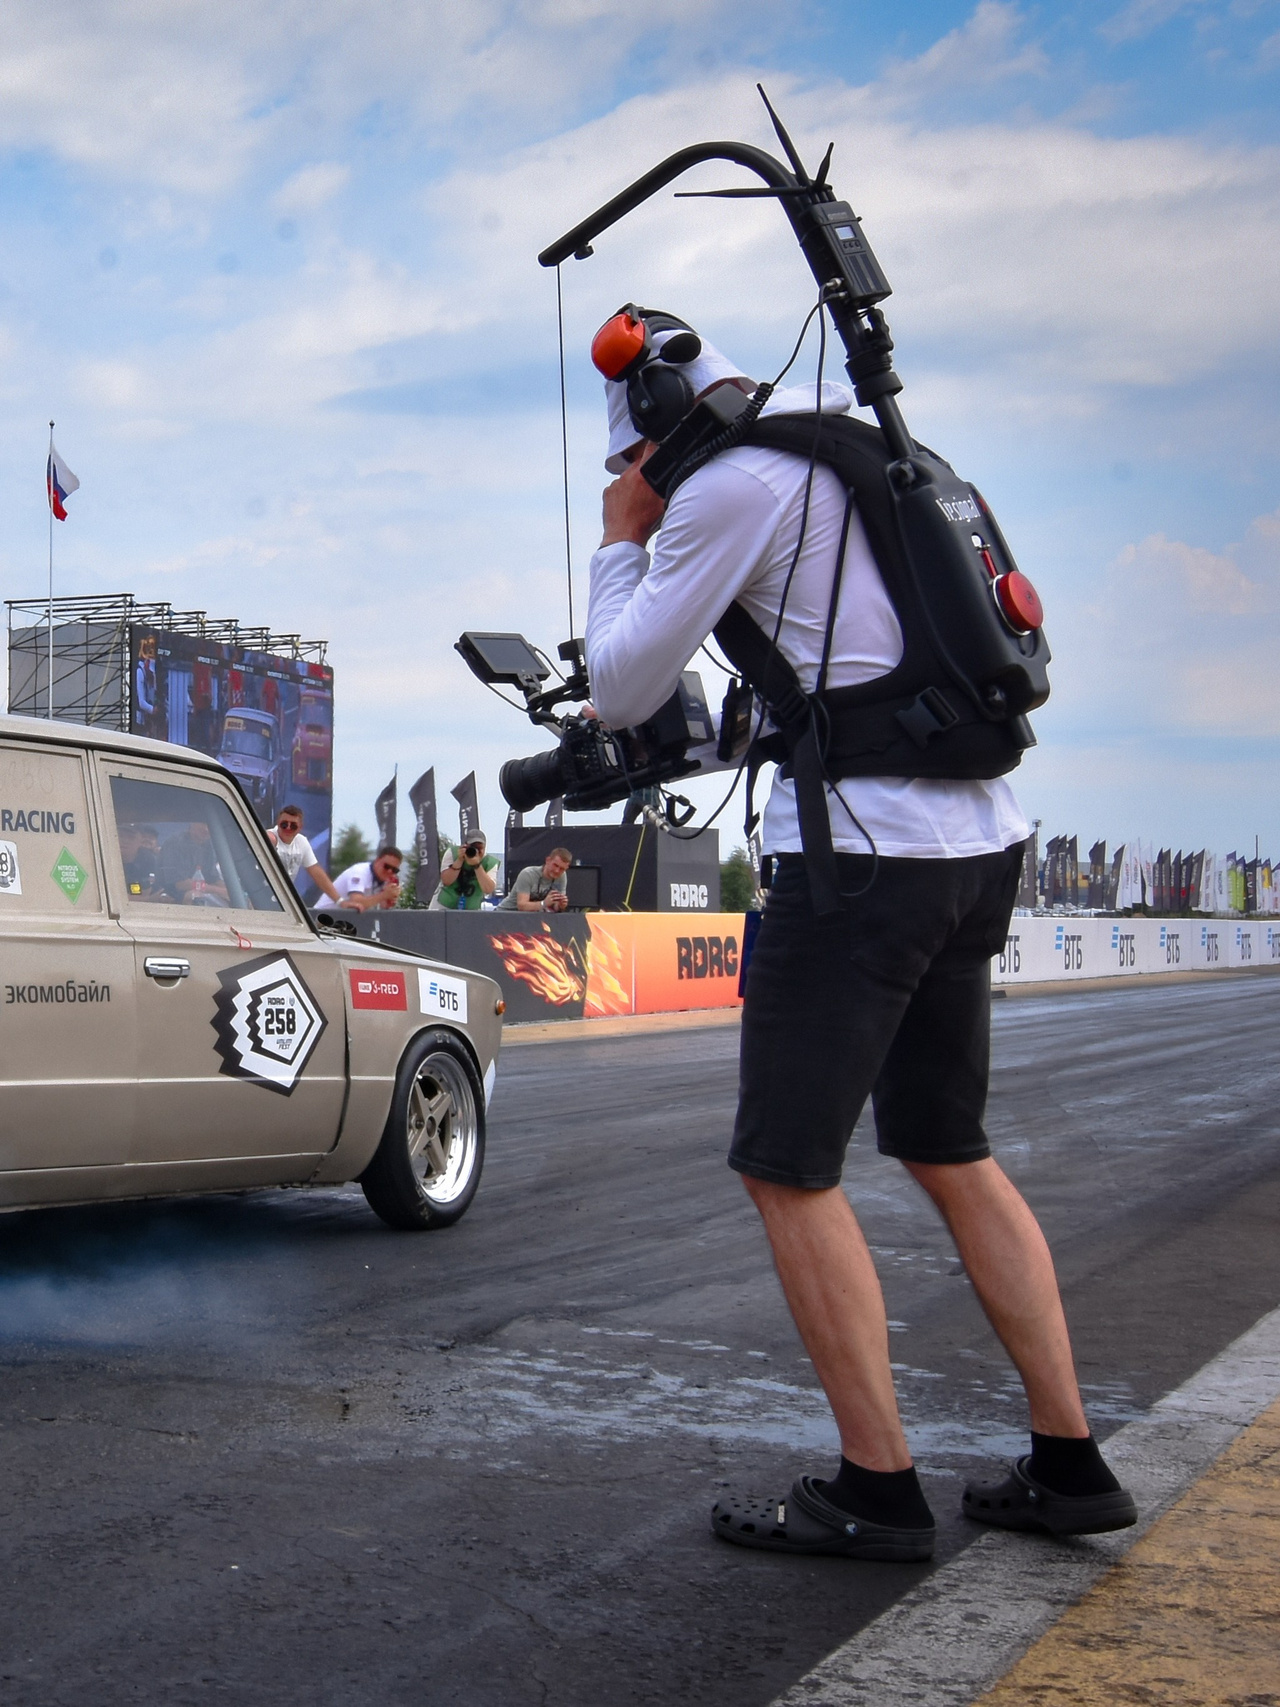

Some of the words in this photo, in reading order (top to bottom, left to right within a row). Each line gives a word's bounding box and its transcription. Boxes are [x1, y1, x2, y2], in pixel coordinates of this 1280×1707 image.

[1, 809, 75, 834] RACING
[670, 883, 708, 908] RDRC
[676, 936, 738, 980] RDRC
[1064, 934, 1082, 970] ВТБ
[1119, 934, 1135, 967] ВТБ
[1166, 933, 1180, 964] ВТБ
[1207, 933, 1218, 962] ВТБ
[5, 980, 111, 1004] экомобайл
[439, 988, 459, 1011] ВТБ
[264, 1008, 296, 1035] 258
